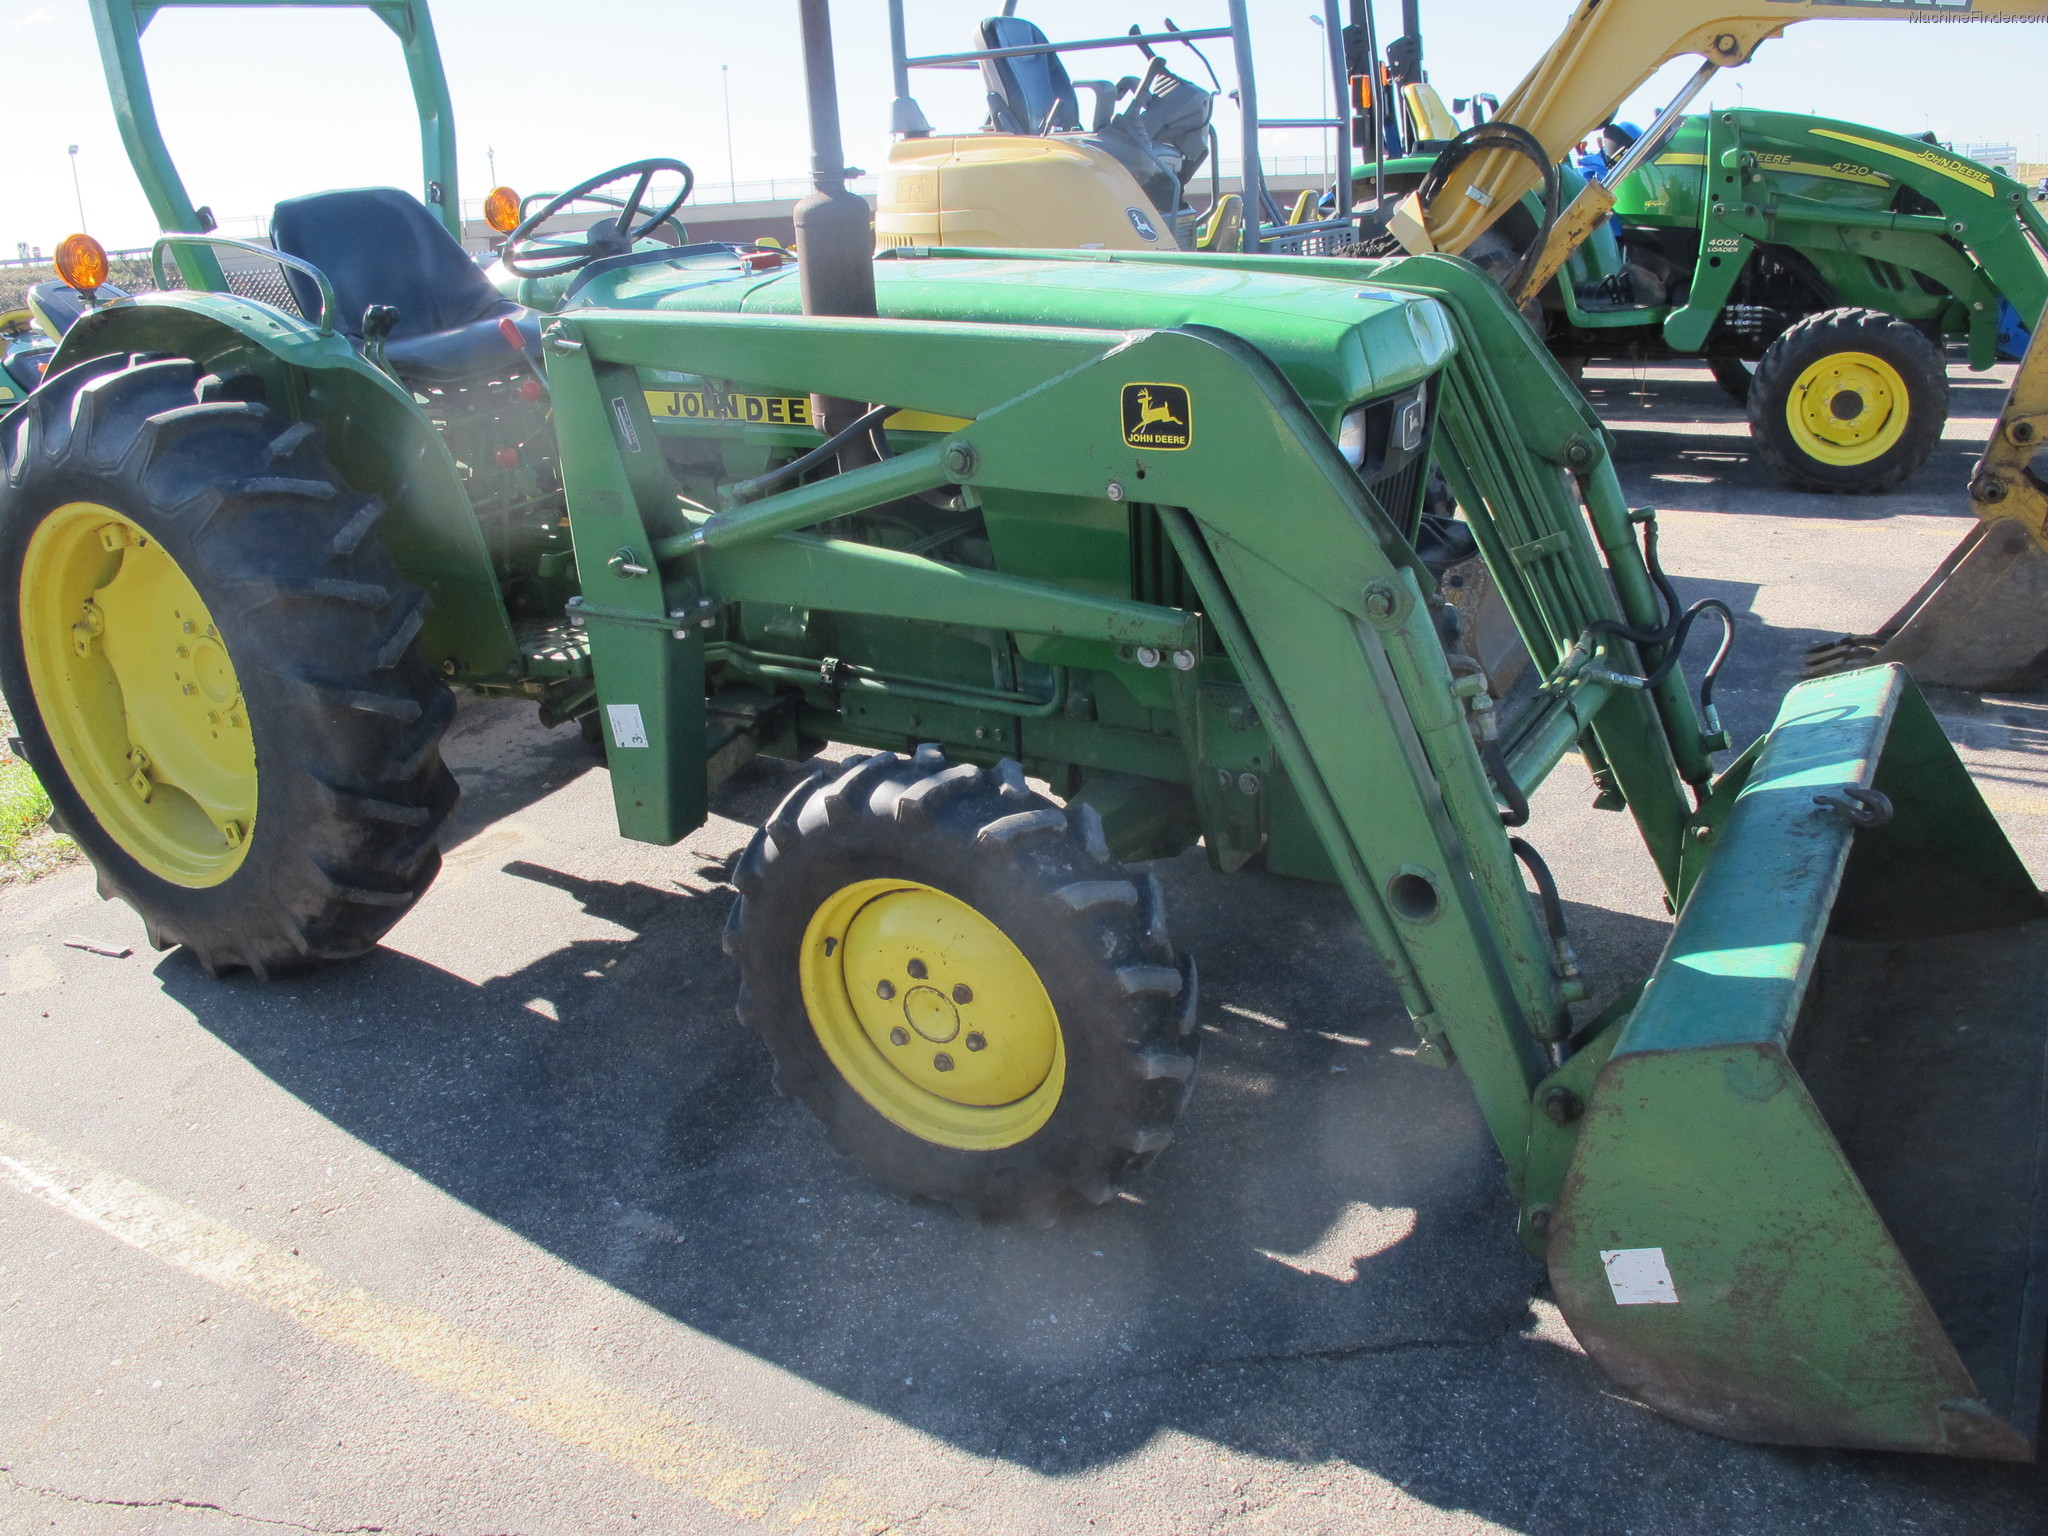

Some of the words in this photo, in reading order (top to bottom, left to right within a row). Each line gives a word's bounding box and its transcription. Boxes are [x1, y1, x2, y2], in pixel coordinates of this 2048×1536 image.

[1831, 162, 1869, 176] 4720
[1128, 433, 1153, 443] JOHN
[1155, 435, 1186, 444] DEERE
